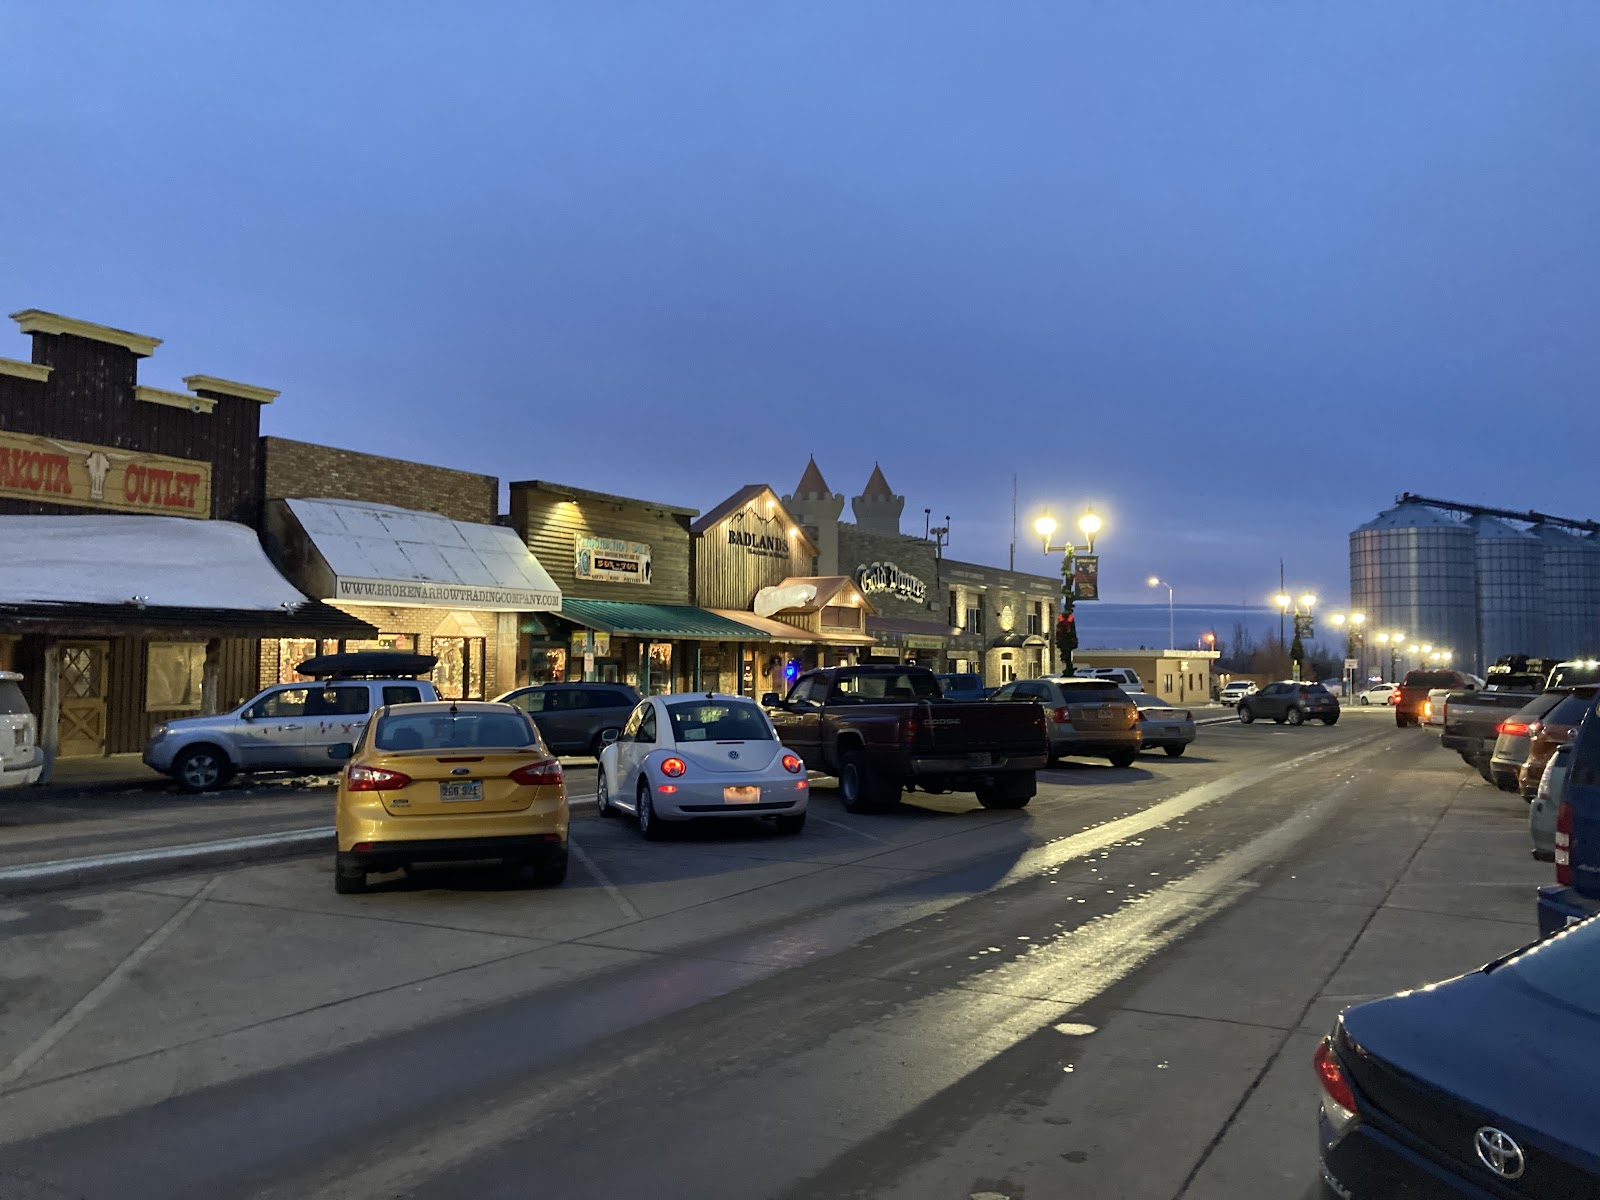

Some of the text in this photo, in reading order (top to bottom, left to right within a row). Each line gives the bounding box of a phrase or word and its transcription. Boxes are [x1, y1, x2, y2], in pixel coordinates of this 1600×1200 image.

[124, 463, 201, 508] OUTLET
[728, 530, 789, 553] BADLANDS
[861, 566, 886, 594] Gold
[340, 581, 559, 606] WWW.BROKENARROWTRADINGCOMPANY.COM
